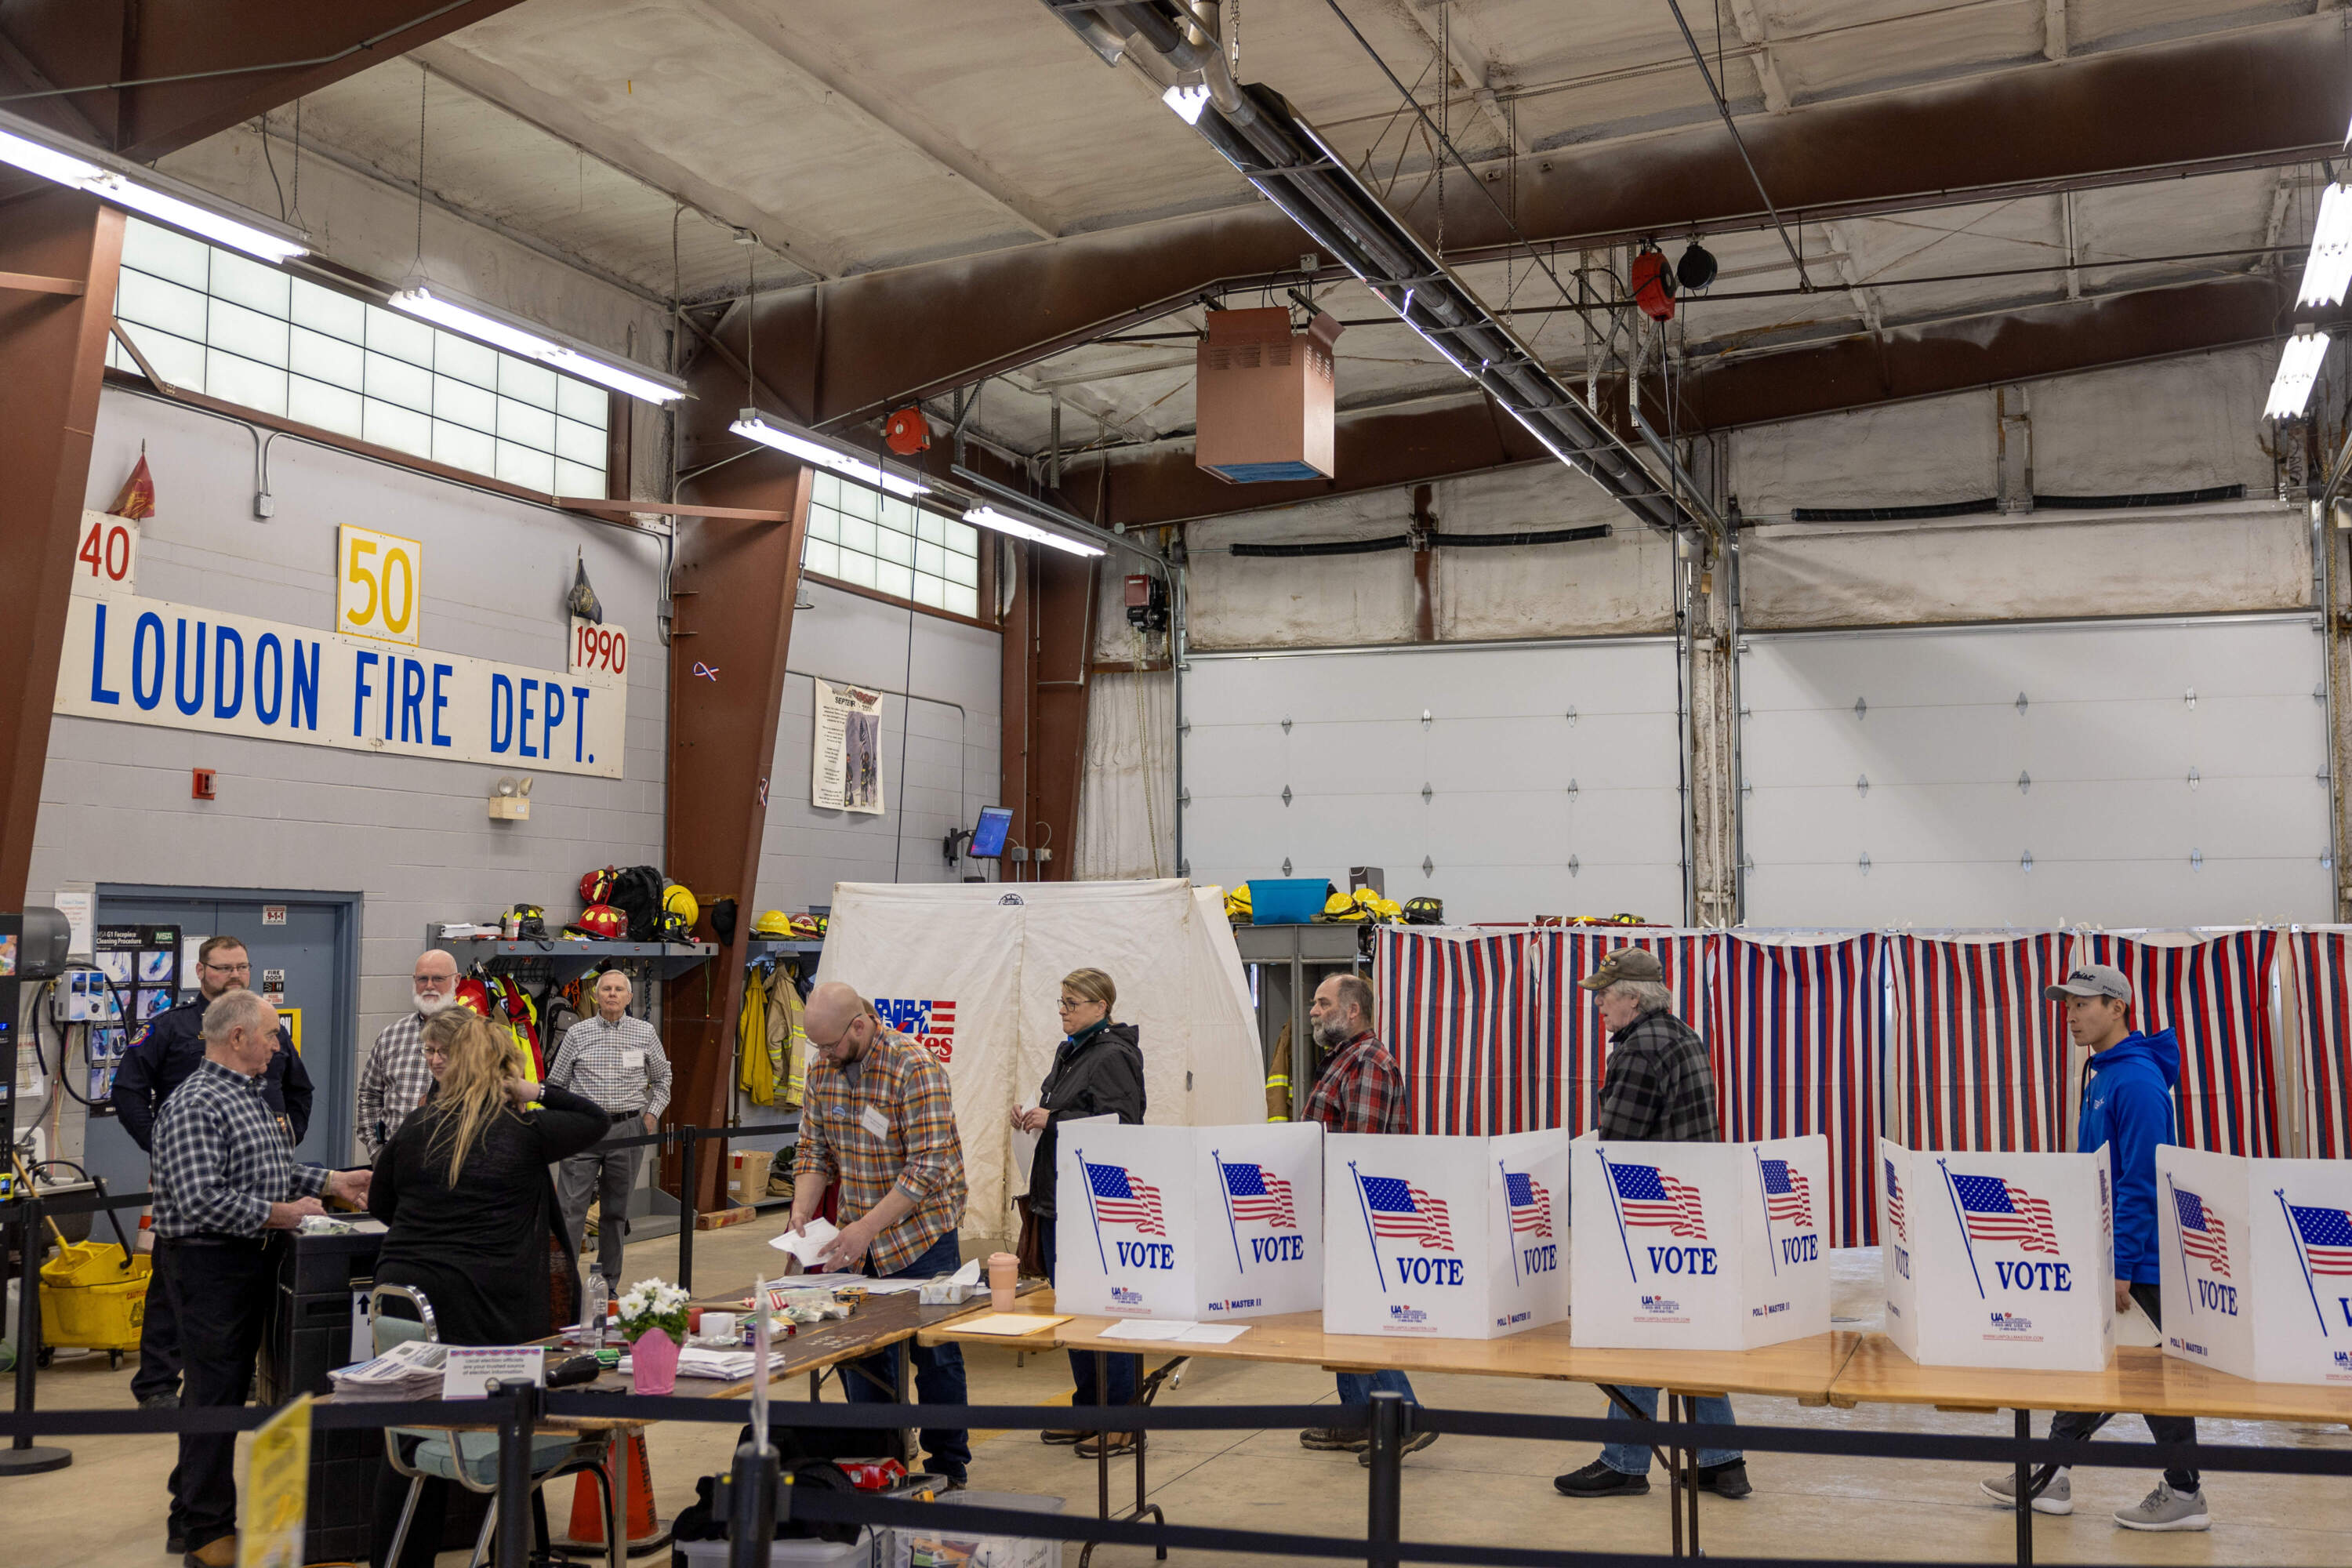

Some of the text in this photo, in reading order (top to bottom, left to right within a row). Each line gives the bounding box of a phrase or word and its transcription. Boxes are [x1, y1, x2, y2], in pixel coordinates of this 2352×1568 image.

[79, 522, 130, 582] 40
[347, 538, 412, 633] 50
[577, 626, 626, 675] 1990
[91, 603, 594, 764] LOUDON FIRE DEPT.
[1116, 1241, 1174, 1270] VOTE
[1251, 1235, 1304, 1263] VOTE
[1523, 1244, 1557, 1275] VOTE
[1647, 1246, 1718, 1275] VOTE
[1781, 1234, 1818, 1265] VOTE
[1396, 1257, 1464, 1286] VOTE
[1994, 1261, 2071, 1292] VOTE
[1111, 1287, 1122, 1295] UA
[1208, 1302, 1224, 1312] POLL
[1231, 1298, 1255, 1309] MASTER
[1642, 1295, 1654, 1305] UA
[2198, 1278, 2238, 1316] VOTE
[1391, 1305, 1403, 1314] UA
[1497, 1317, 1507, 1327] POLL
[1512, 1312, 1526, 1324] MASTER
[1752, 1307, 1763, 1317] POLL
[1768, 1302, 1785, 1314] MASTER
[1991, 1312, 2004, 1322] UA
[2170, 1337, 2181, 1348] POLL
[2185, 1341, 2203, 1355] MASTER
[2334, 1351, 2349, 1361] UA
